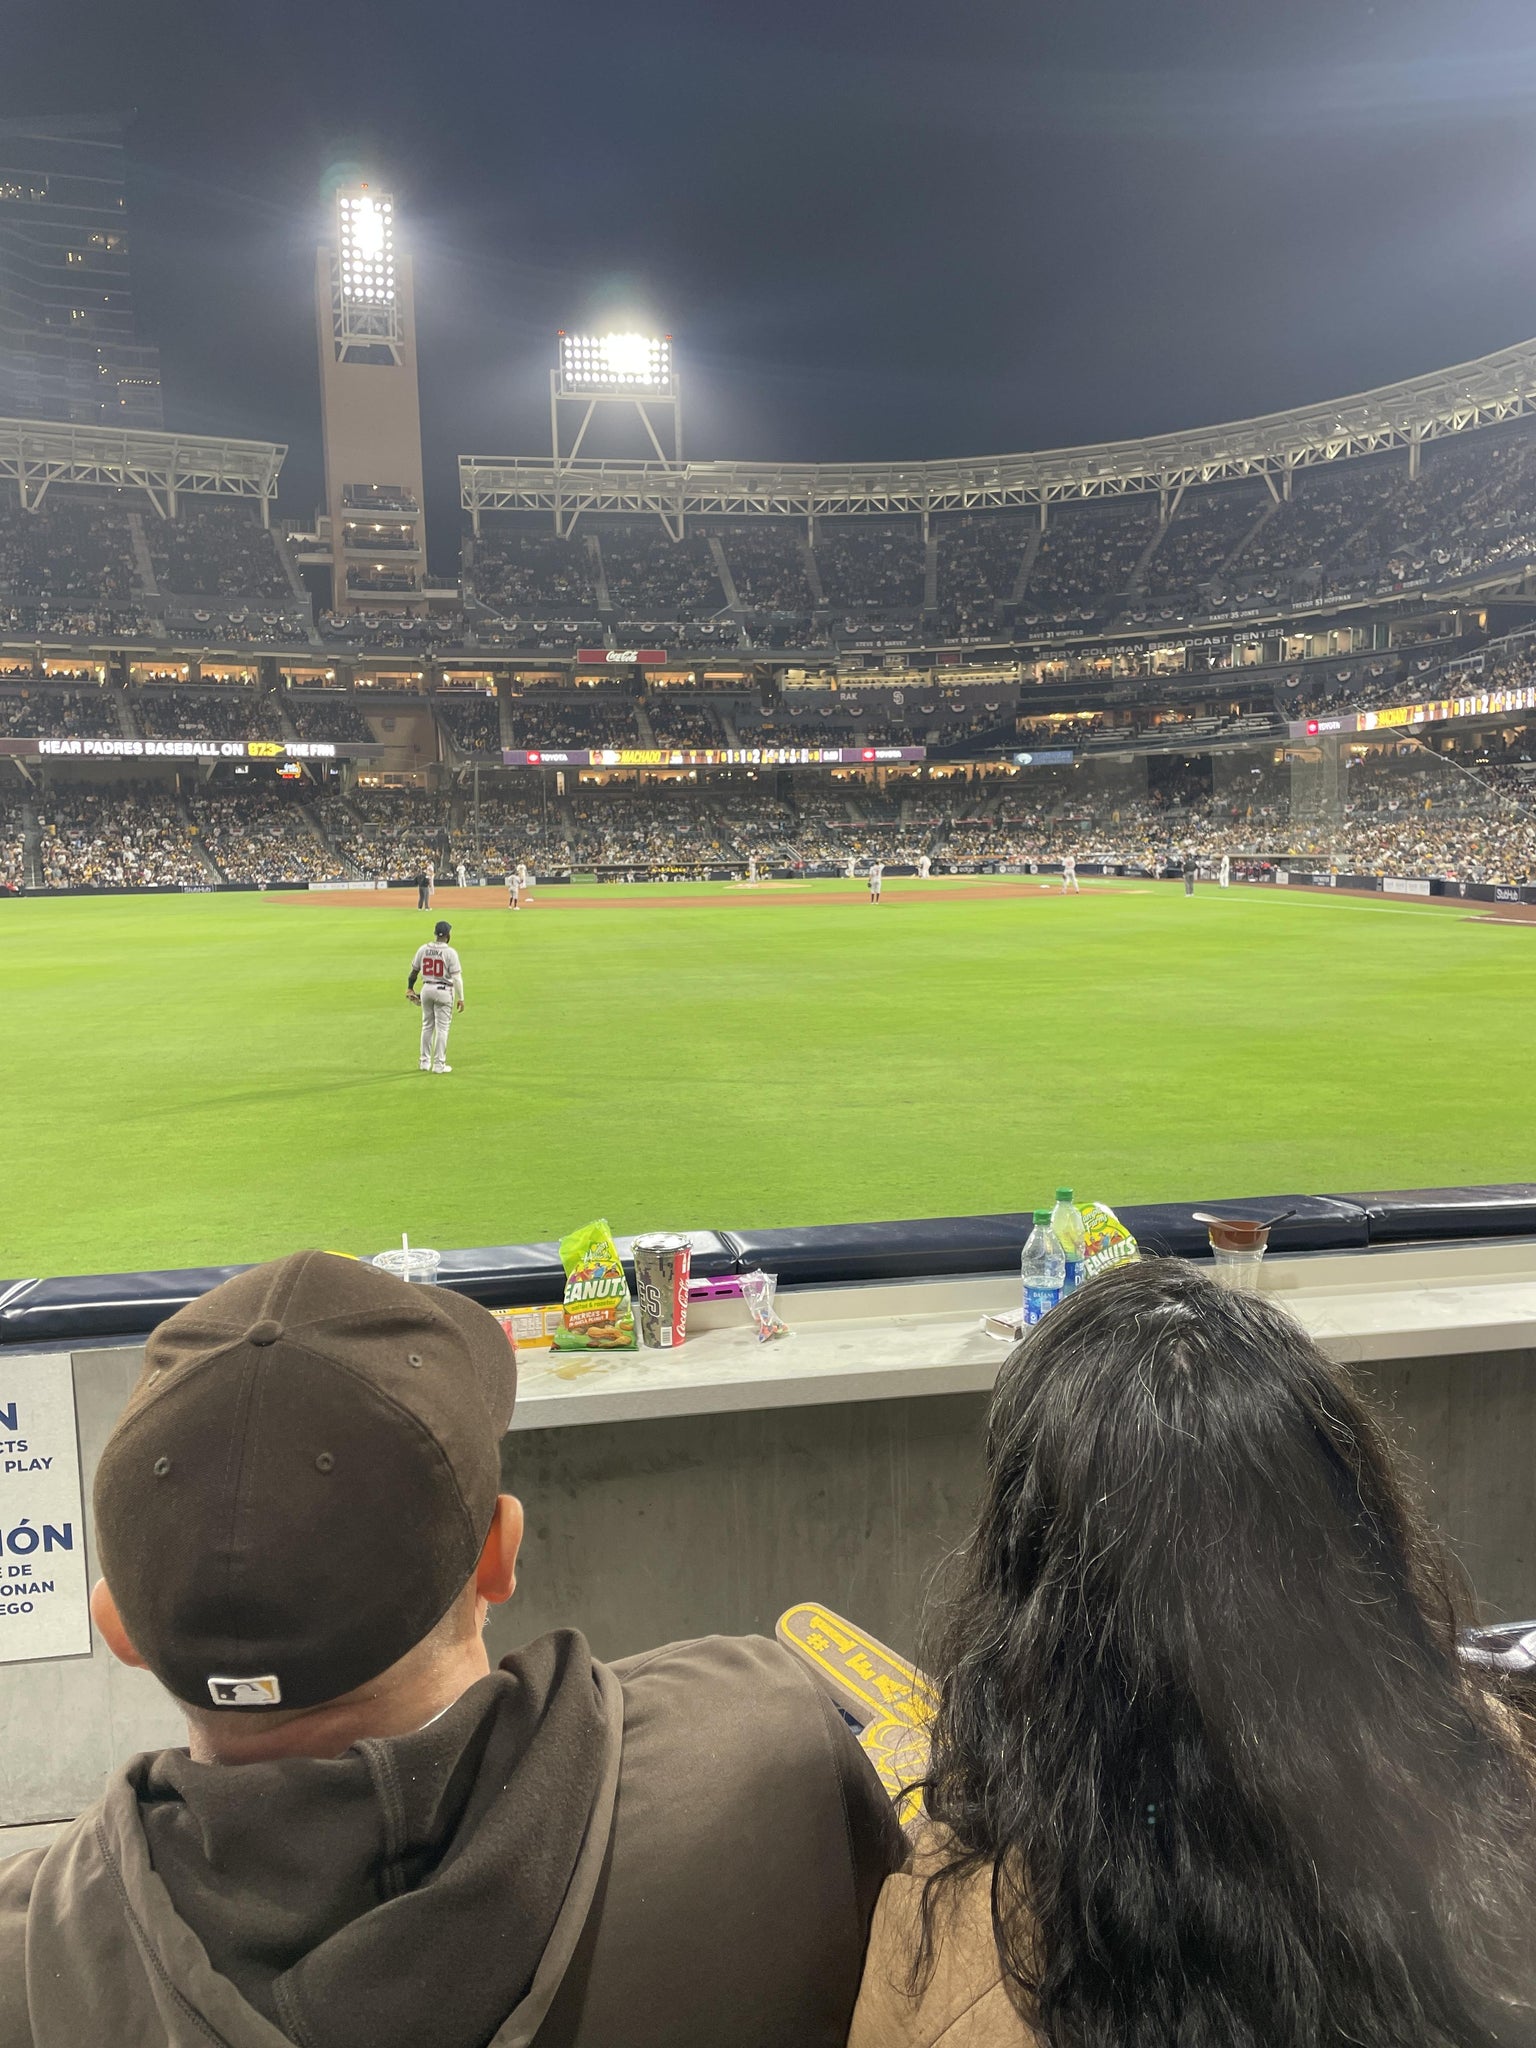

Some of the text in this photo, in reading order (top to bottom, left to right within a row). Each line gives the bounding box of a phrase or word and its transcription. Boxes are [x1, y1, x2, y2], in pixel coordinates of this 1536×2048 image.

[1035, 628, 1284, 660] JERRY COLEMAN BROADCAST CENTER
[840, 692, 858, 700] RAK
[38, 741, 81, 754] HEAR
[84, 741, 142, 755] PADRES
[145, 742, 219, 756] BASEBALL
[221, 743, 243, 756] ON
[285, 744, 309, 757] THE
[540, 753, 568, 761] TOYOTA
[621, 751, 661, 763] MACHADO
[422, 957, 444, 978] 20
[1084, 1235, 1136, 1277] EANUTS
[564, 1276, 628, 1304] EANUTS
[5, 1457, 53, 1473] PLAY
[8, 1565, 32, 1577] DE
